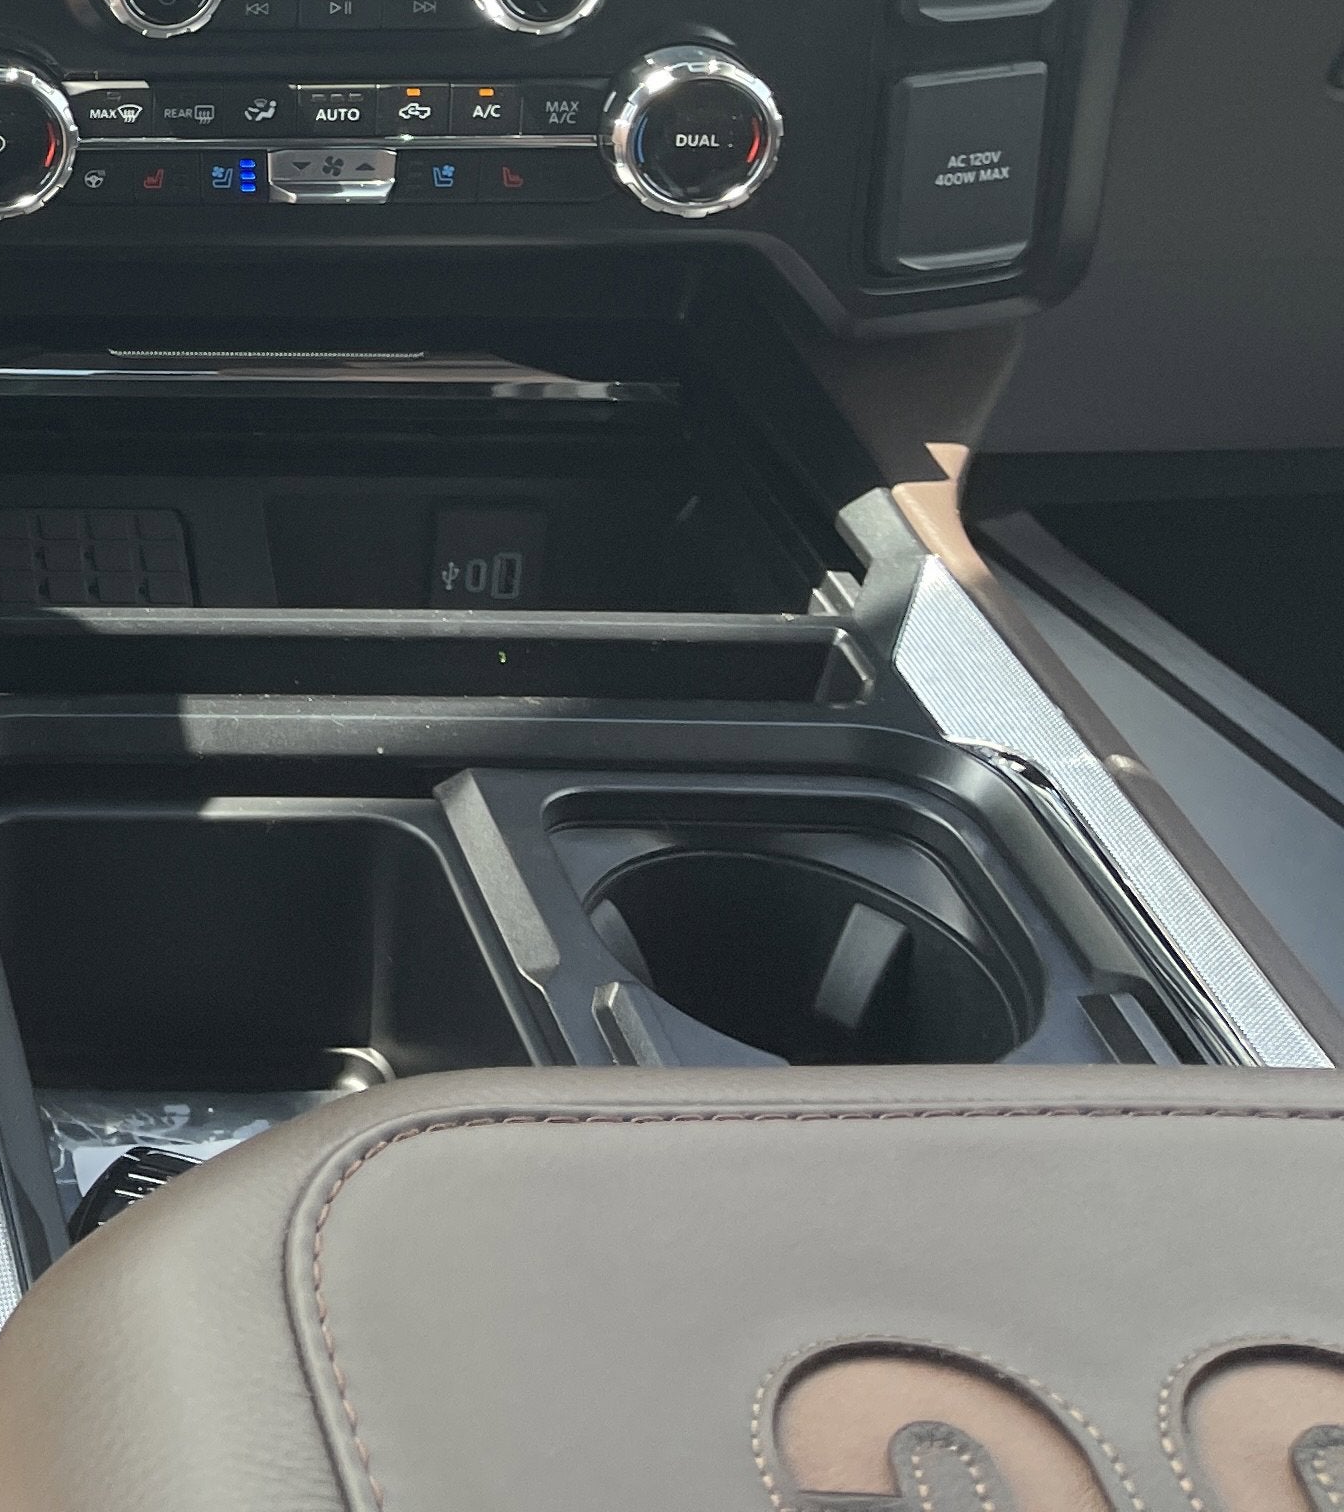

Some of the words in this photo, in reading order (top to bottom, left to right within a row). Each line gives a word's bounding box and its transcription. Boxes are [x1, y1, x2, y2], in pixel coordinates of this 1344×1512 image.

[89, 107, 117, 121] MAX
[163, 108, 193, 121] REAR
[315, 107, 361, 123] AUTO
[472, 103, 501, 120] A/C
[545, 100, 579, 114] MAX
[548, 109, 577, 125] A/C
[675, 133, 720, 148] DUAL
[947, 154, 968, 169] AC
[970, 150, 1001, 168] 120V
[934, 169, 976, 187] 400W
[979, 166, 1010, 182] MAX
